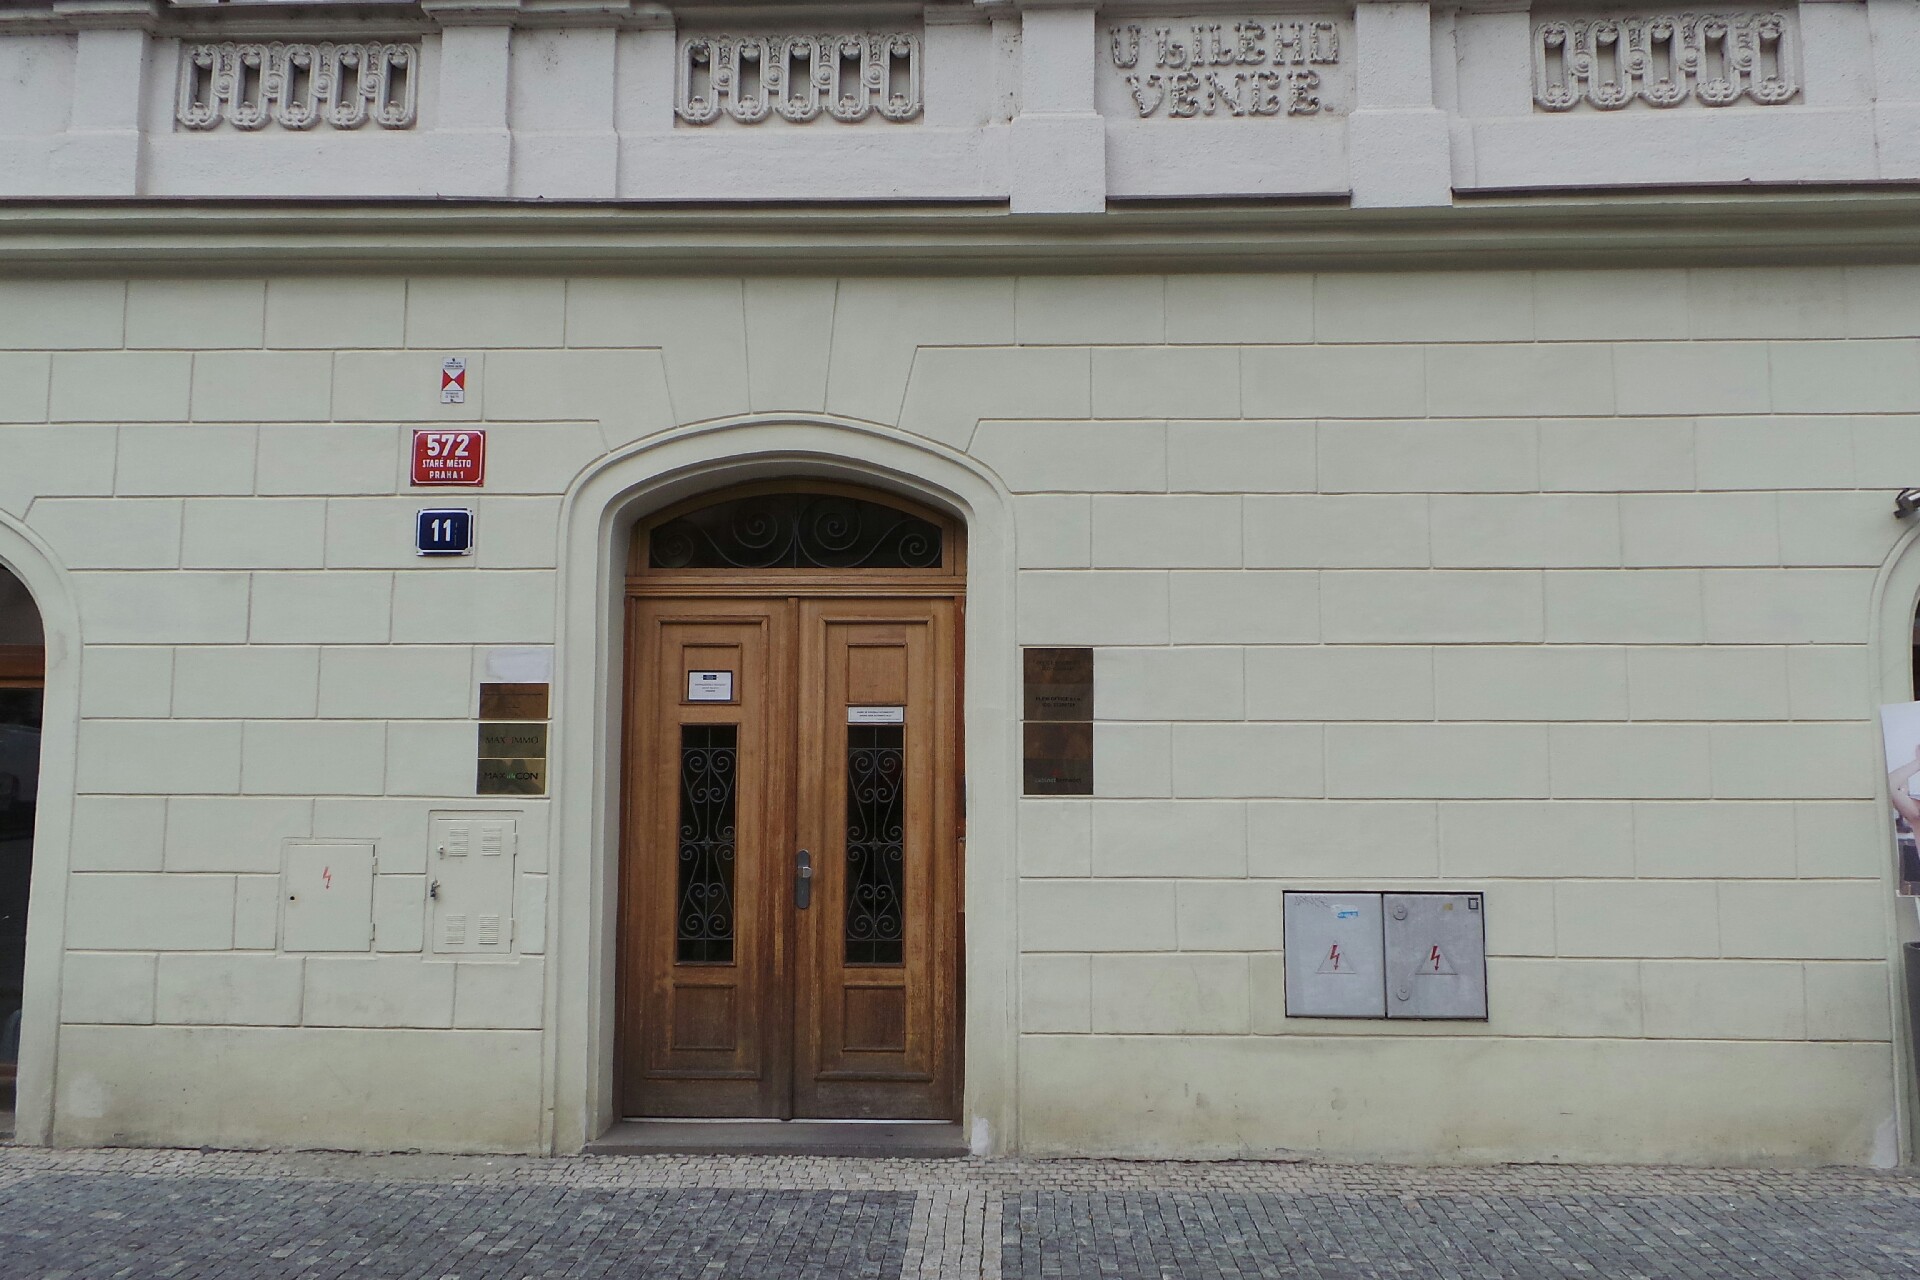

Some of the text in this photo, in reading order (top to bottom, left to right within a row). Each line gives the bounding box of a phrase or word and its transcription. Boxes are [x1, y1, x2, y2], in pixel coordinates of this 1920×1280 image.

[1109, 24, 1141, 68] U
[427, 434, 469, 457] 572
[422, 457, 472, 468] STARÉ MĚSTO
[429, 470, 464, 479] PRAHA 1
[431, 518, 452, 542] 11
